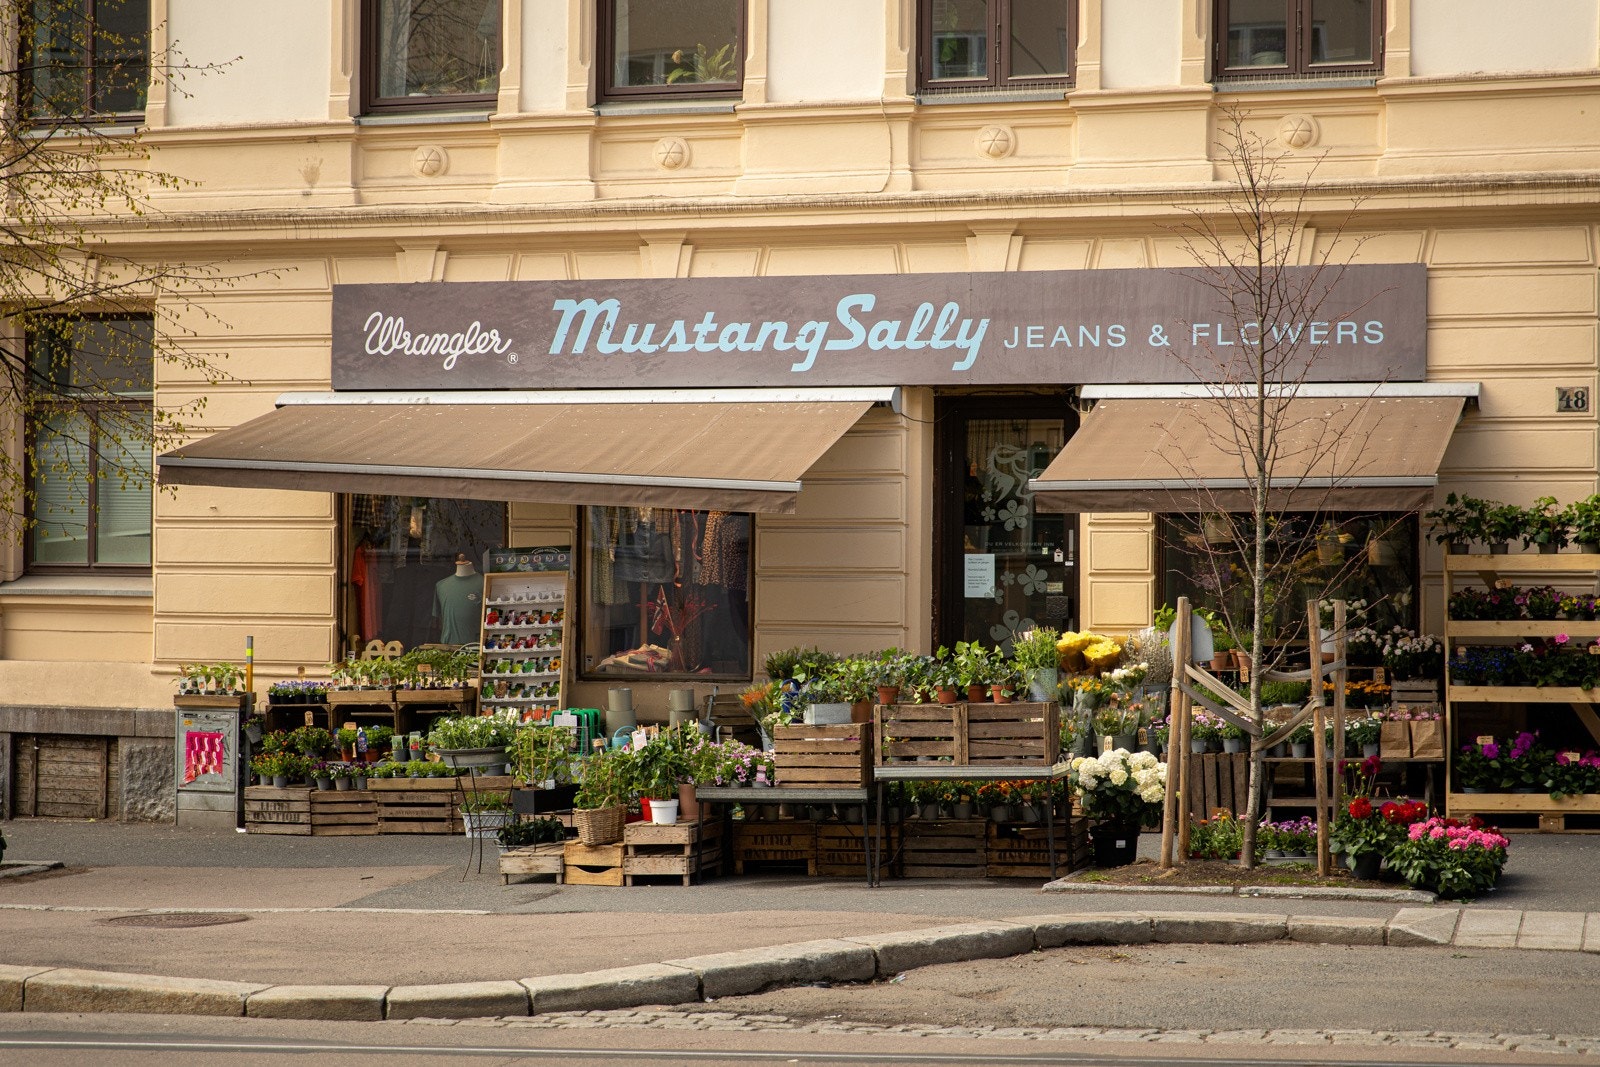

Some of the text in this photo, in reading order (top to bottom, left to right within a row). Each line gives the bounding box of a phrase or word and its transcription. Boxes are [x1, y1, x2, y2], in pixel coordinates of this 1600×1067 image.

[363, 311, 512, 371] Wrangler
[1003, 320, 1385, 349] JEANS & FLOWERS
[1558, 390, 1586, 409] 48
